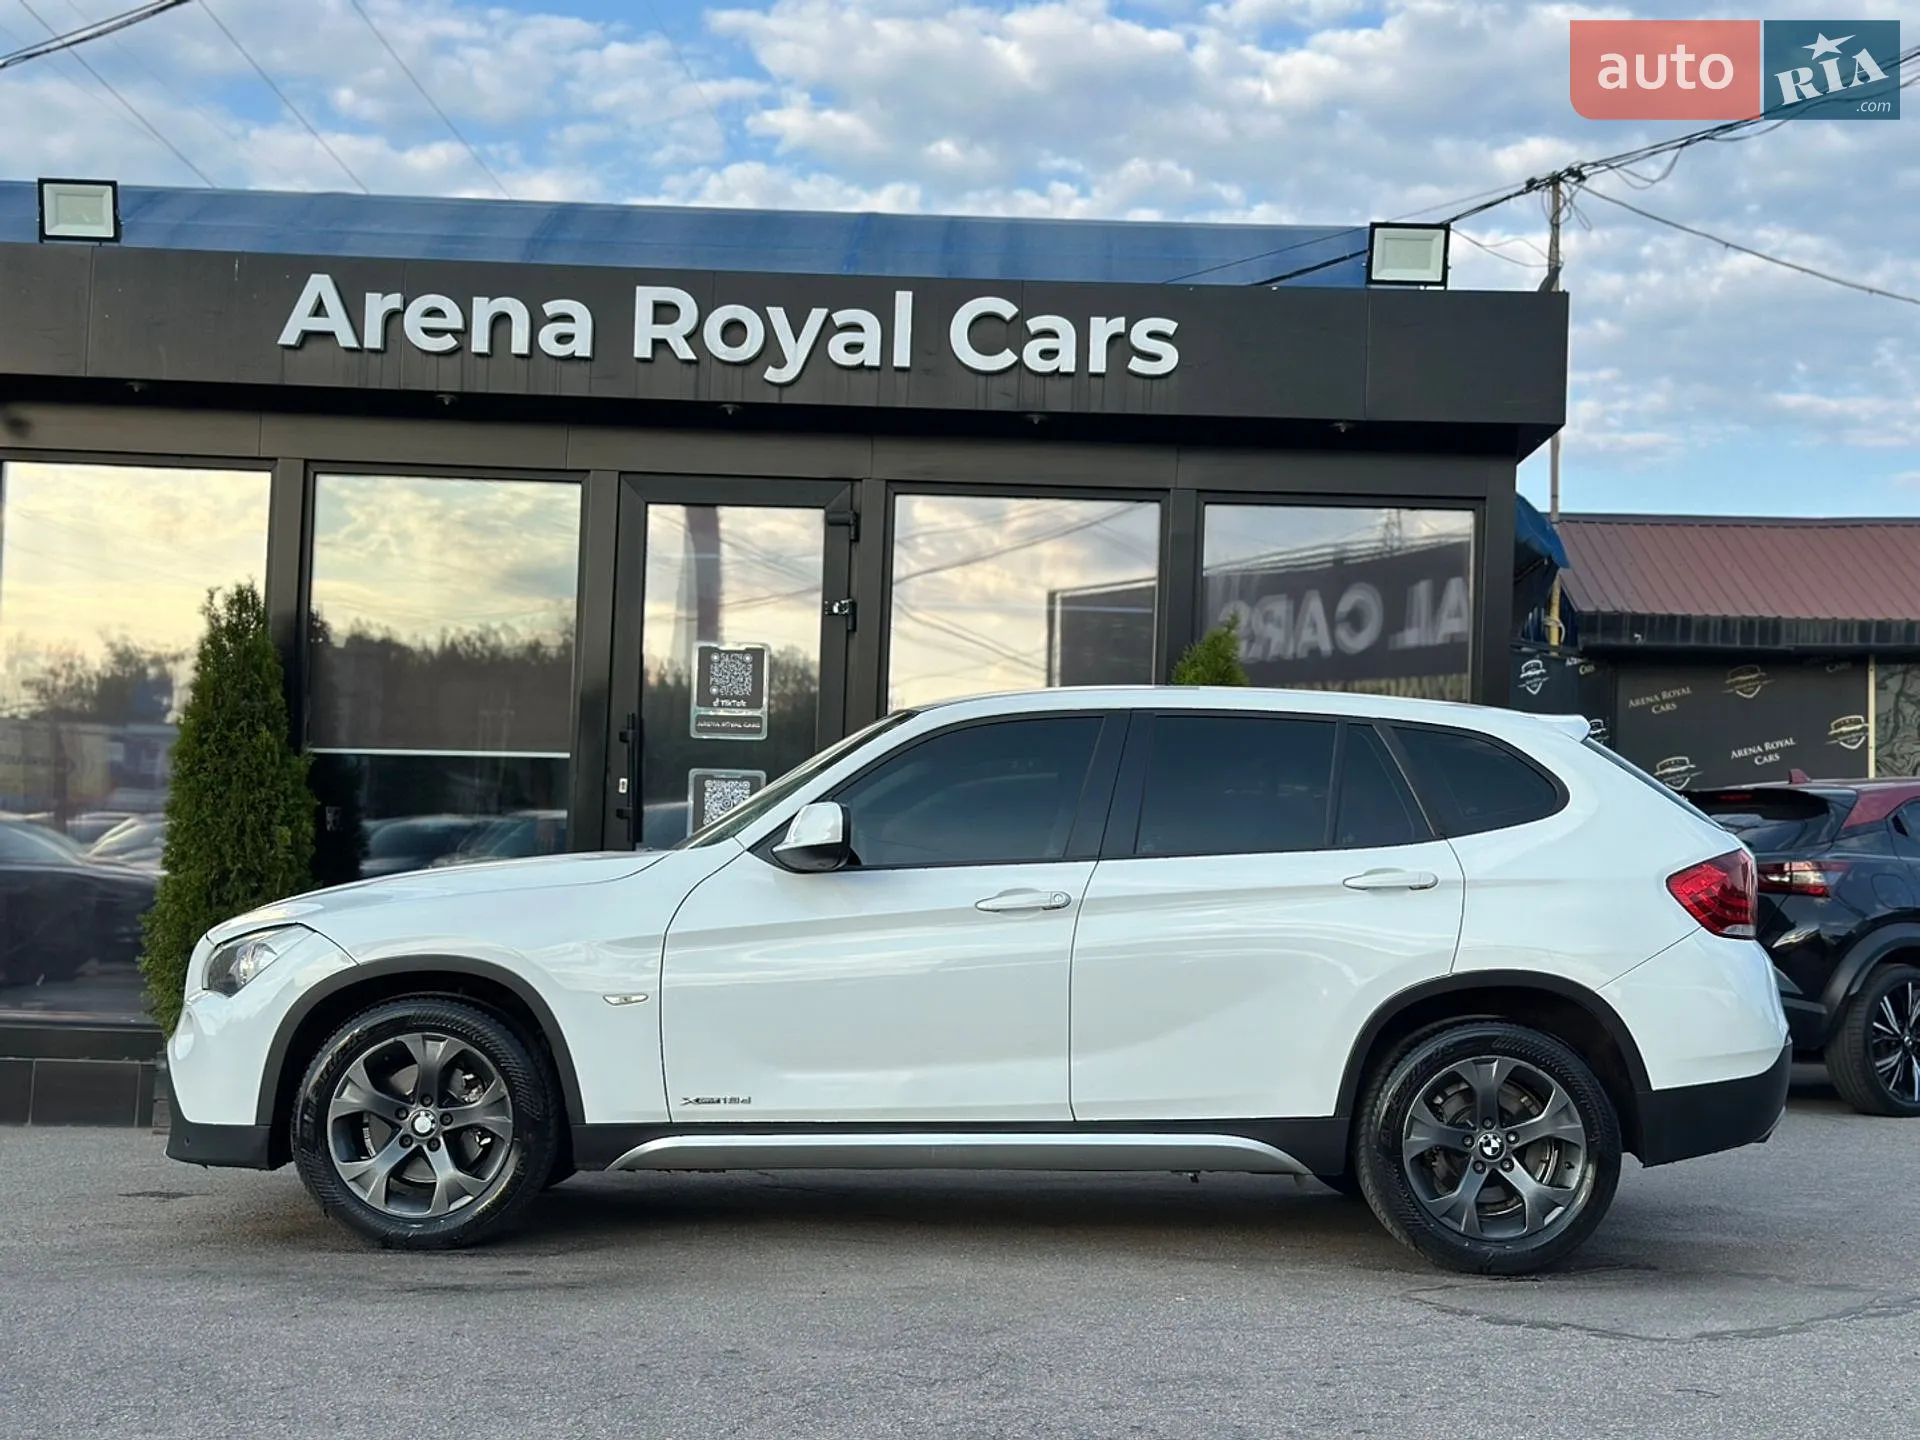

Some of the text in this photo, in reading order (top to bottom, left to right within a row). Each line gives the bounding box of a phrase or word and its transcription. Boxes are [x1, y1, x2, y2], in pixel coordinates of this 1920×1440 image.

[277, 273, 1180, 385] Arena Royal Cars
[1730, 737, 1796, 760] ARENA ROYAL
[1754, 752, 1781, 766] CARS
